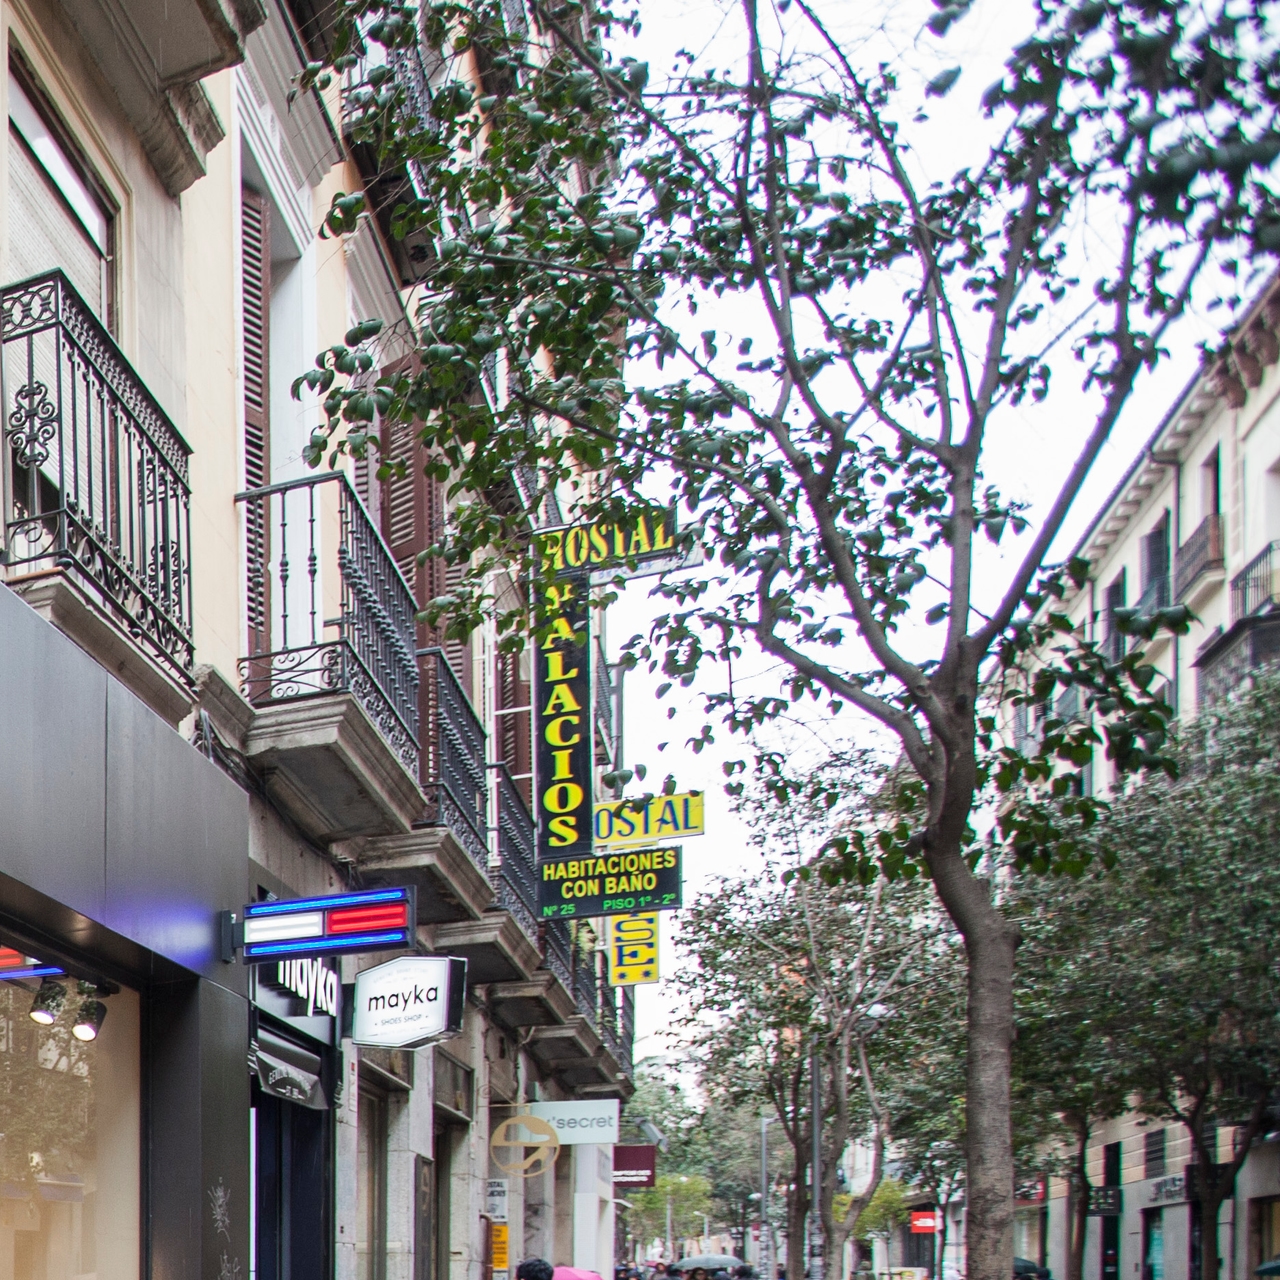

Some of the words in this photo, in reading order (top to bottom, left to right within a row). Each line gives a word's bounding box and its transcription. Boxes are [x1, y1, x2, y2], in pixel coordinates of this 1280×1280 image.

[595, 798, 699, 840] OSTAL
[543, 850, 676, 881] HABITACIONES
[561, 879, 600, 899] CON
[605, 871, 657, 895] BAÑO
[543, 905, 558, 917] Nº
[560, 904, 576, 915] 25
[603, 898, 635, 911] PISO
[278, 957, 338, 1017] mayka
[368, 984, 439, 1012] mayka
[381, 1016, 402, 1027] SHOES
[403, 1014, 423, 1024] SHOP
[546, 1114, 614, 1130] 'secret
